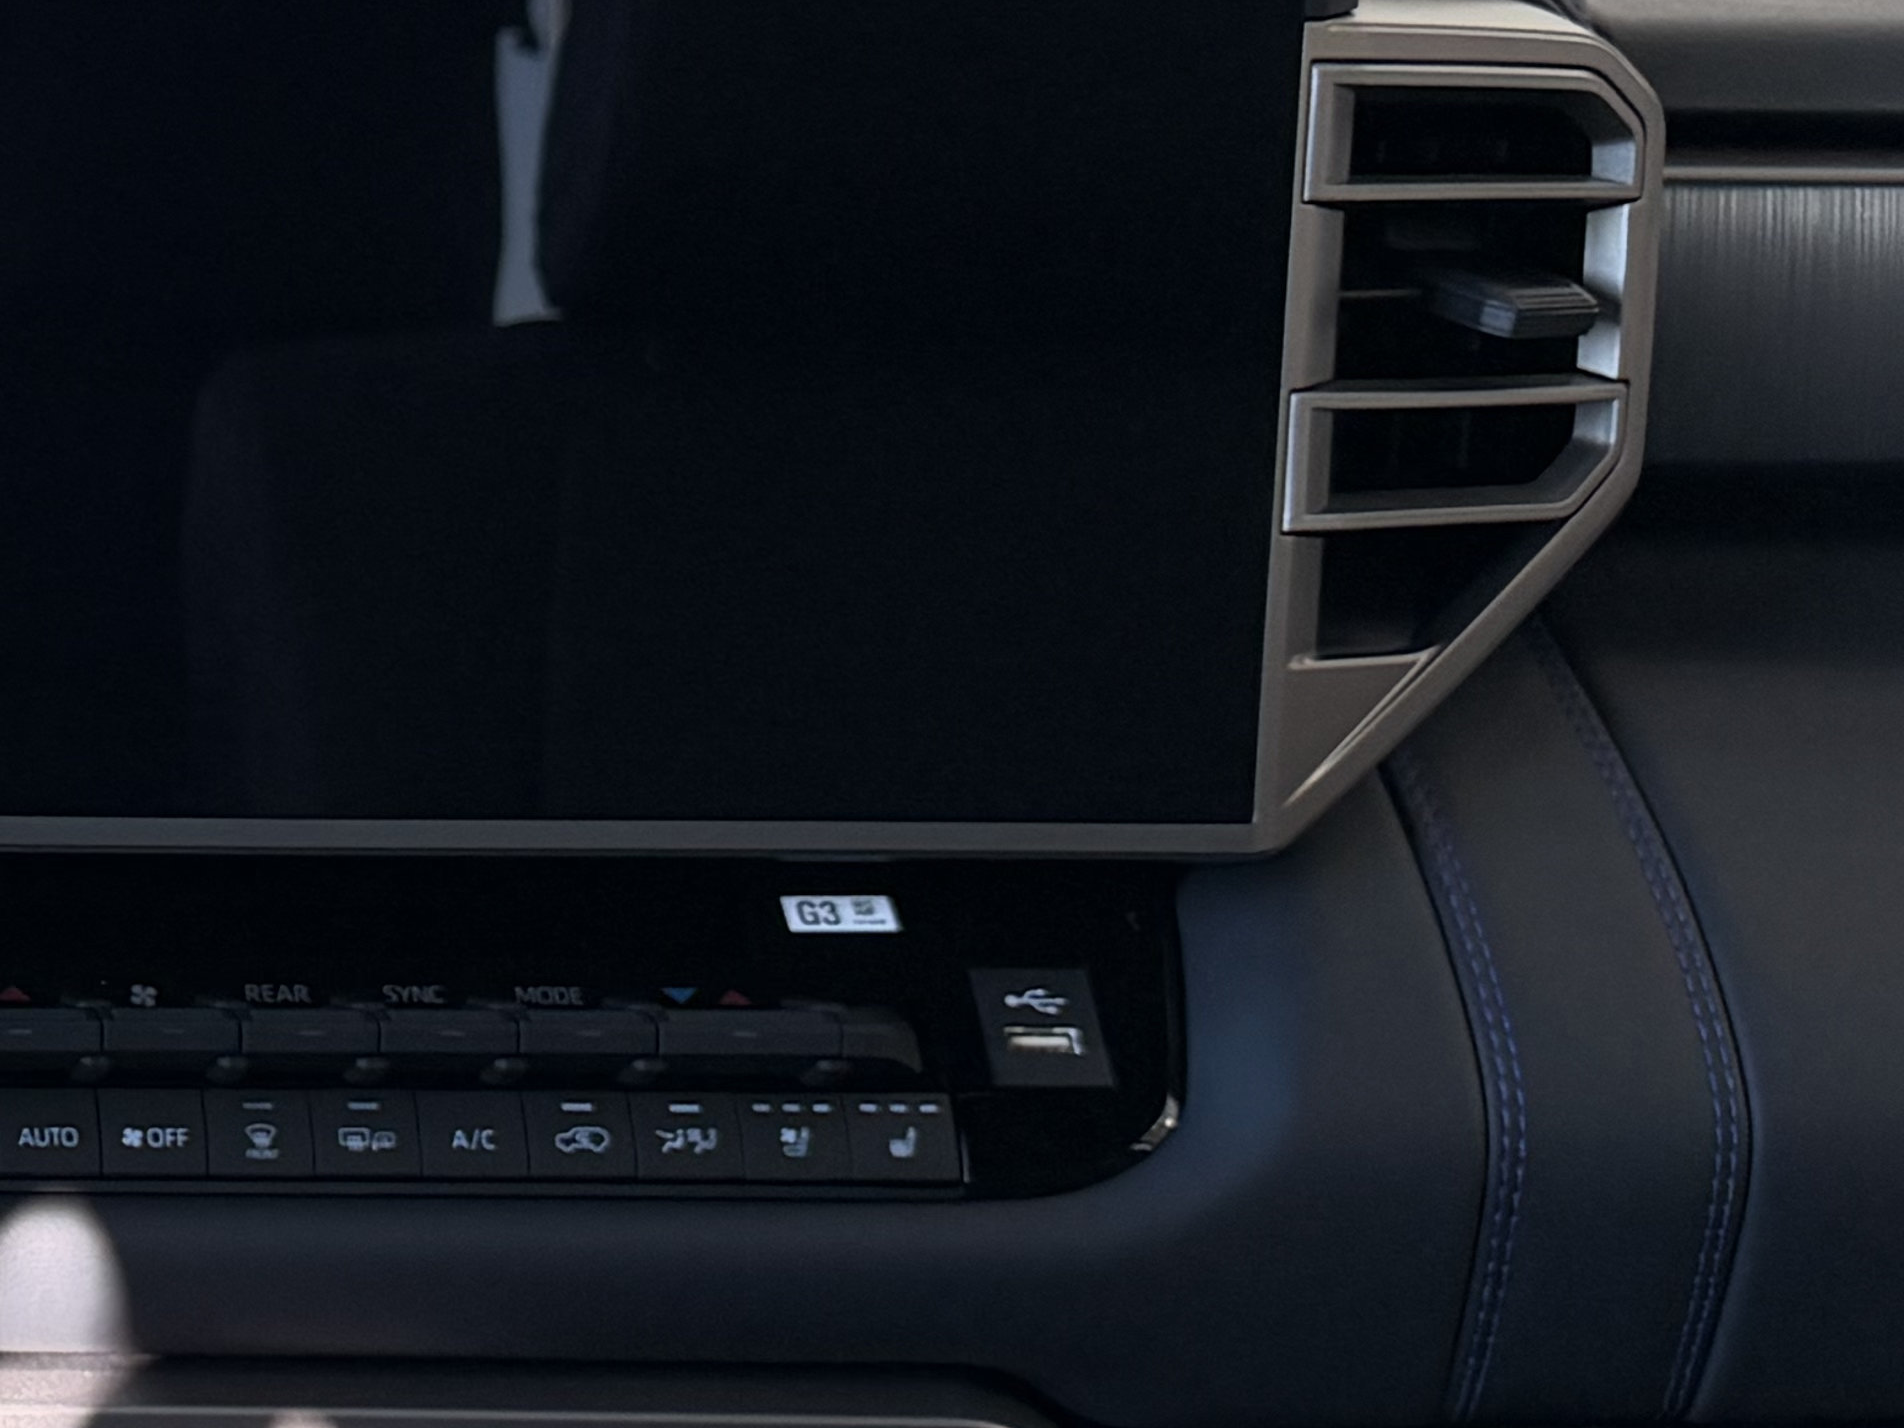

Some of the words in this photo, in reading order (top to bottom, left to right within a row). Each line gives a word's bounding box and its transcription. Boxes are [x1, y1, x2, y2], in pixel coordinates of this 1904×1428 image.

[795, 899, 842, 926] G3
[244, 983, 314, 1004] REAR
[381, 983, 447, 1005] SYNC
[513, 984, 586, 1007] MODE
[17, 1126, 81, 1149] AUTO
[145, 1126, 191, 1149] OFF
[451, 1127, 499, 1152] A/C
